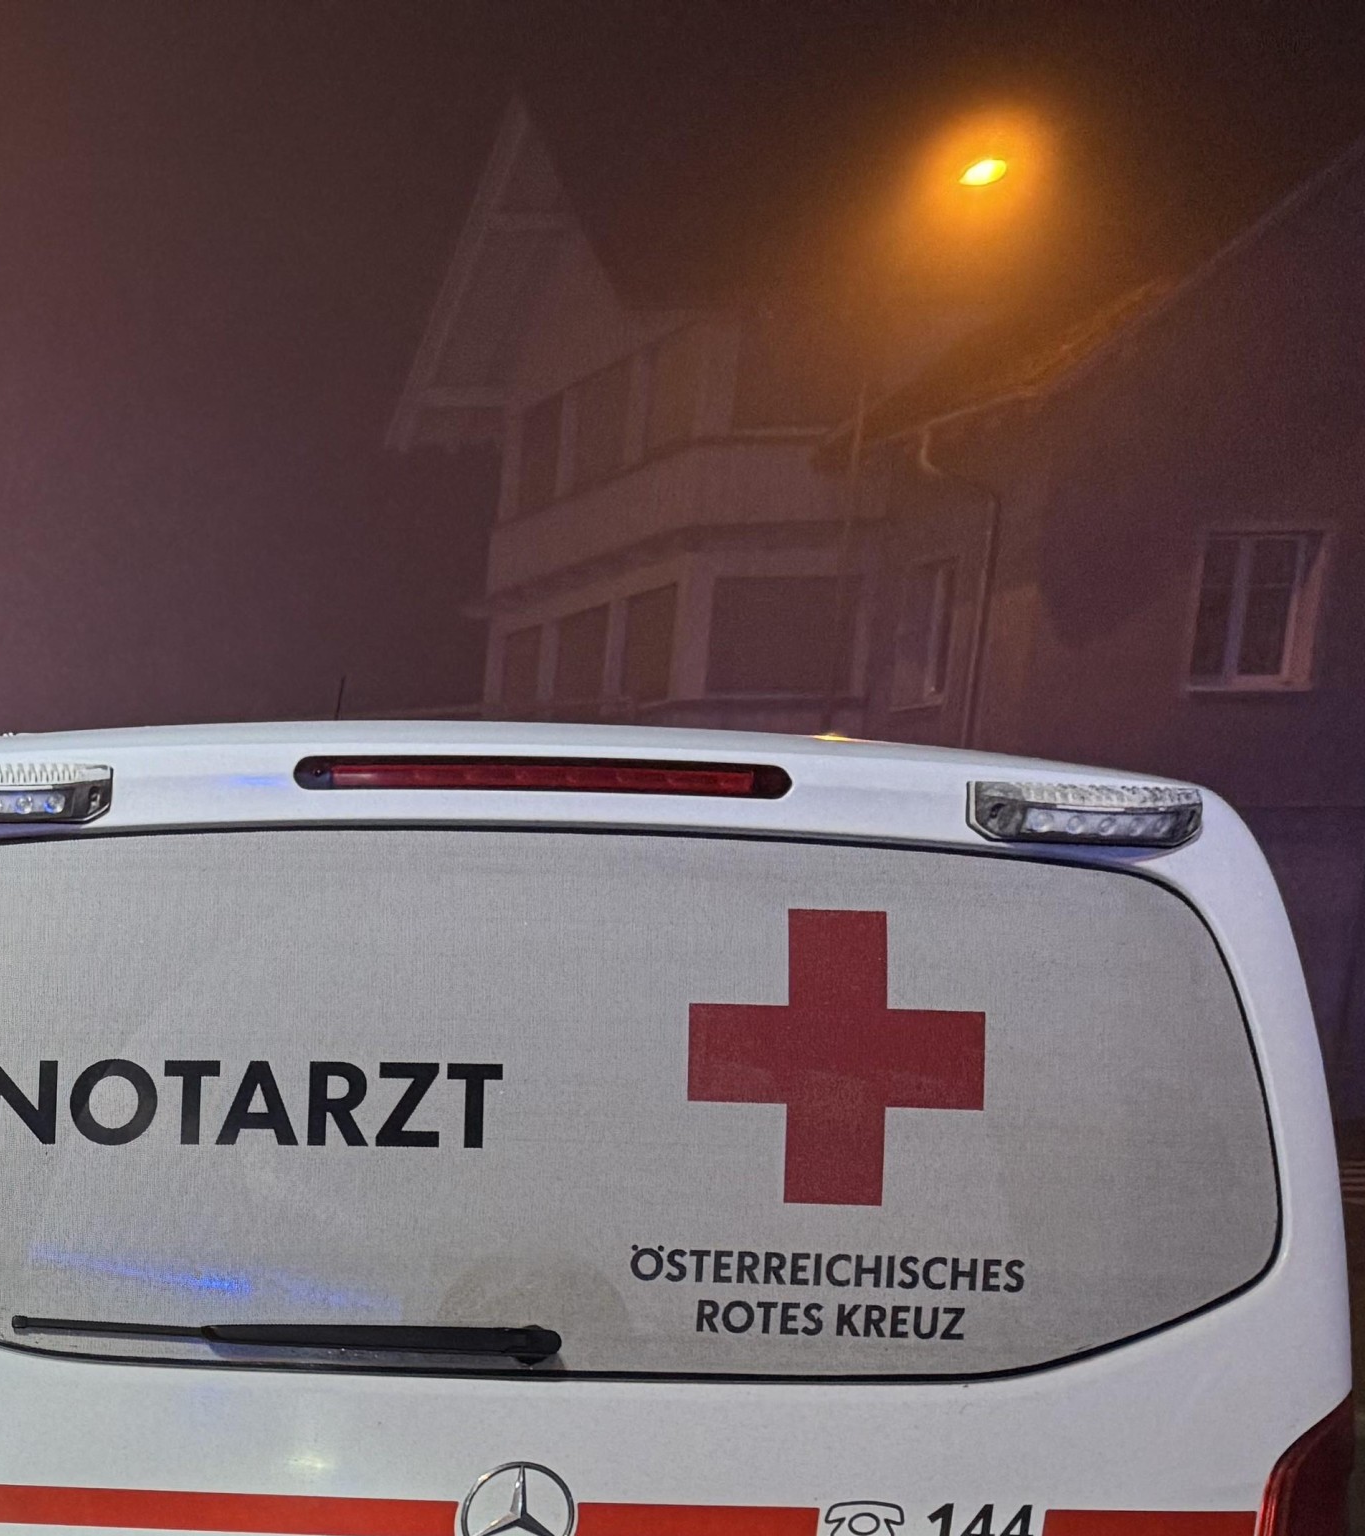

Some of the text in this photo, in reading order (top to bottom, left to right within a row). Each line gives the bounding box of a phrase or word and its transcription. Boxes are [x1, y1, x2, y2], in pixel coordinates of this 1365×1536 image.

[630, 1244, 1026, 1293] ÖSTERREICHISCHES
[696, 1300, 966, 1341] ROTES KREUZ
